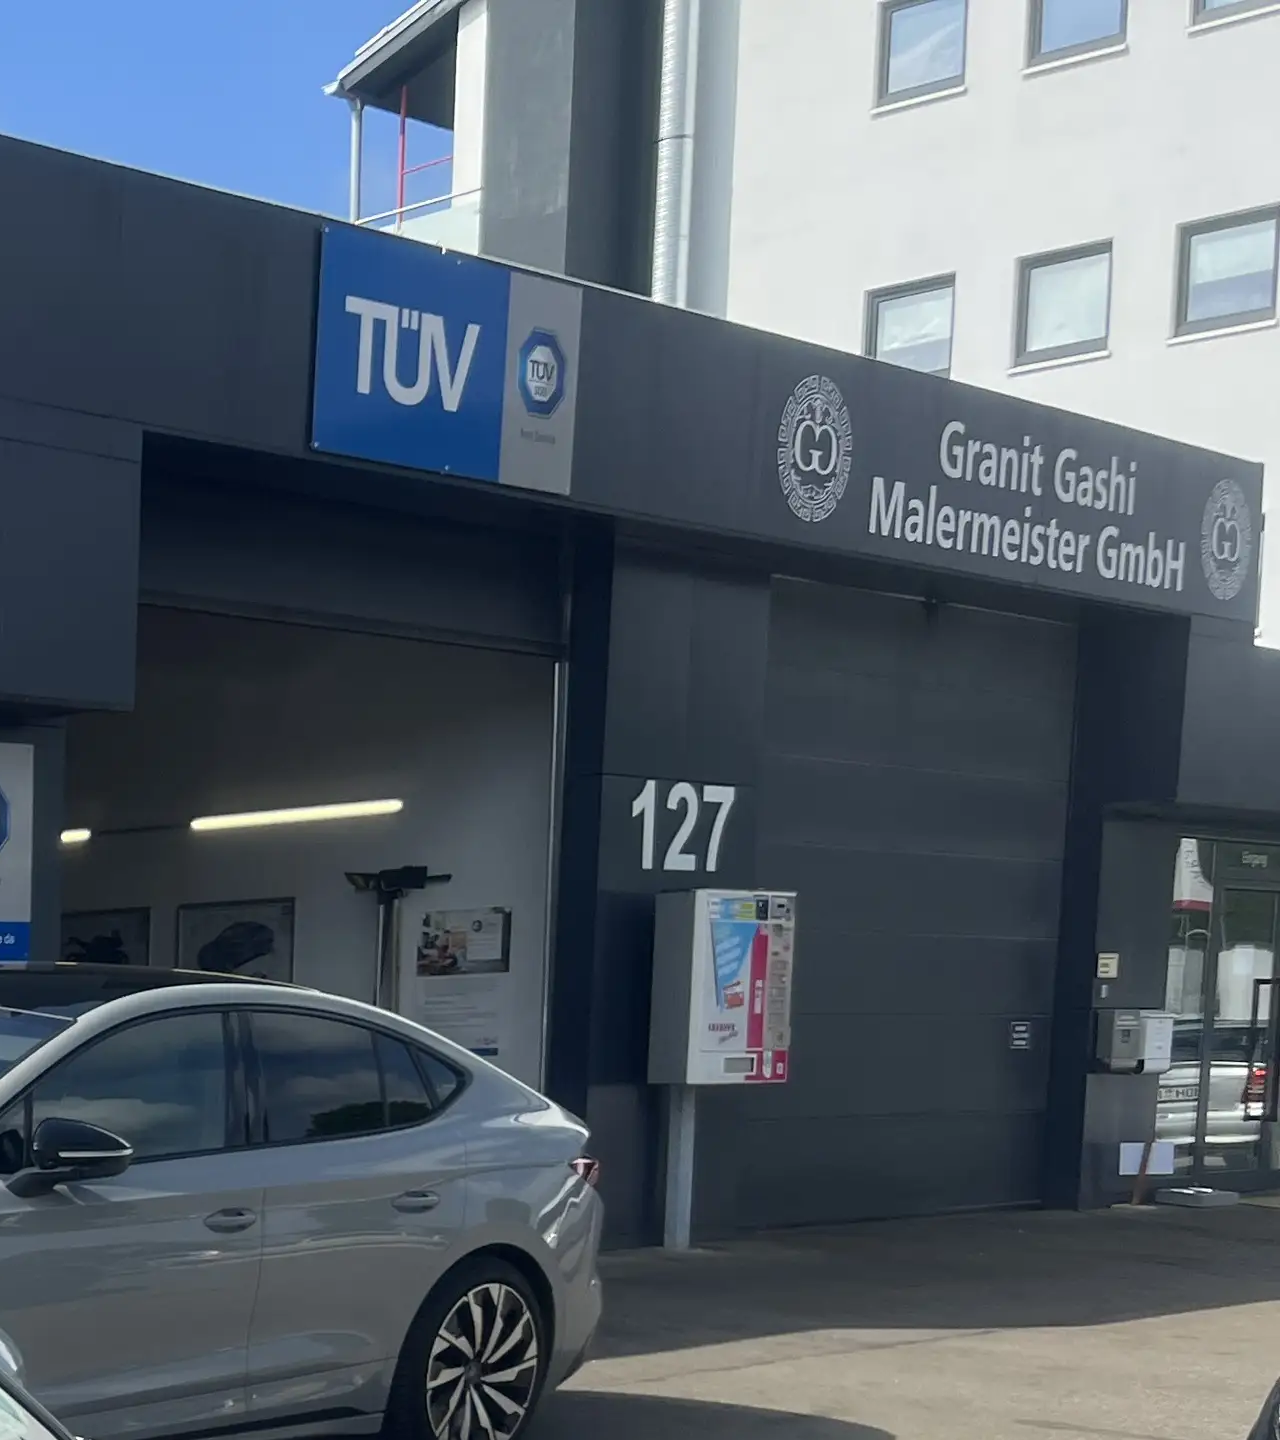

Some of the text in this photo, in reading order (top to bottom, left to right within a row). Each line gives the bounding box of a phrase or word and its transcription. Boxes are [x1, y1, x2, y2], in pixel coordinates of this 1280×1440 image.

[345, 295, 481, 412] TÜV
[528, 359, 555, 381] TÜV
[940, 421, 1138, 516] Granit Gashi
[867, 476, 1186, 592] Malermeister GmbH
[631, 779, 735, 872] 127
